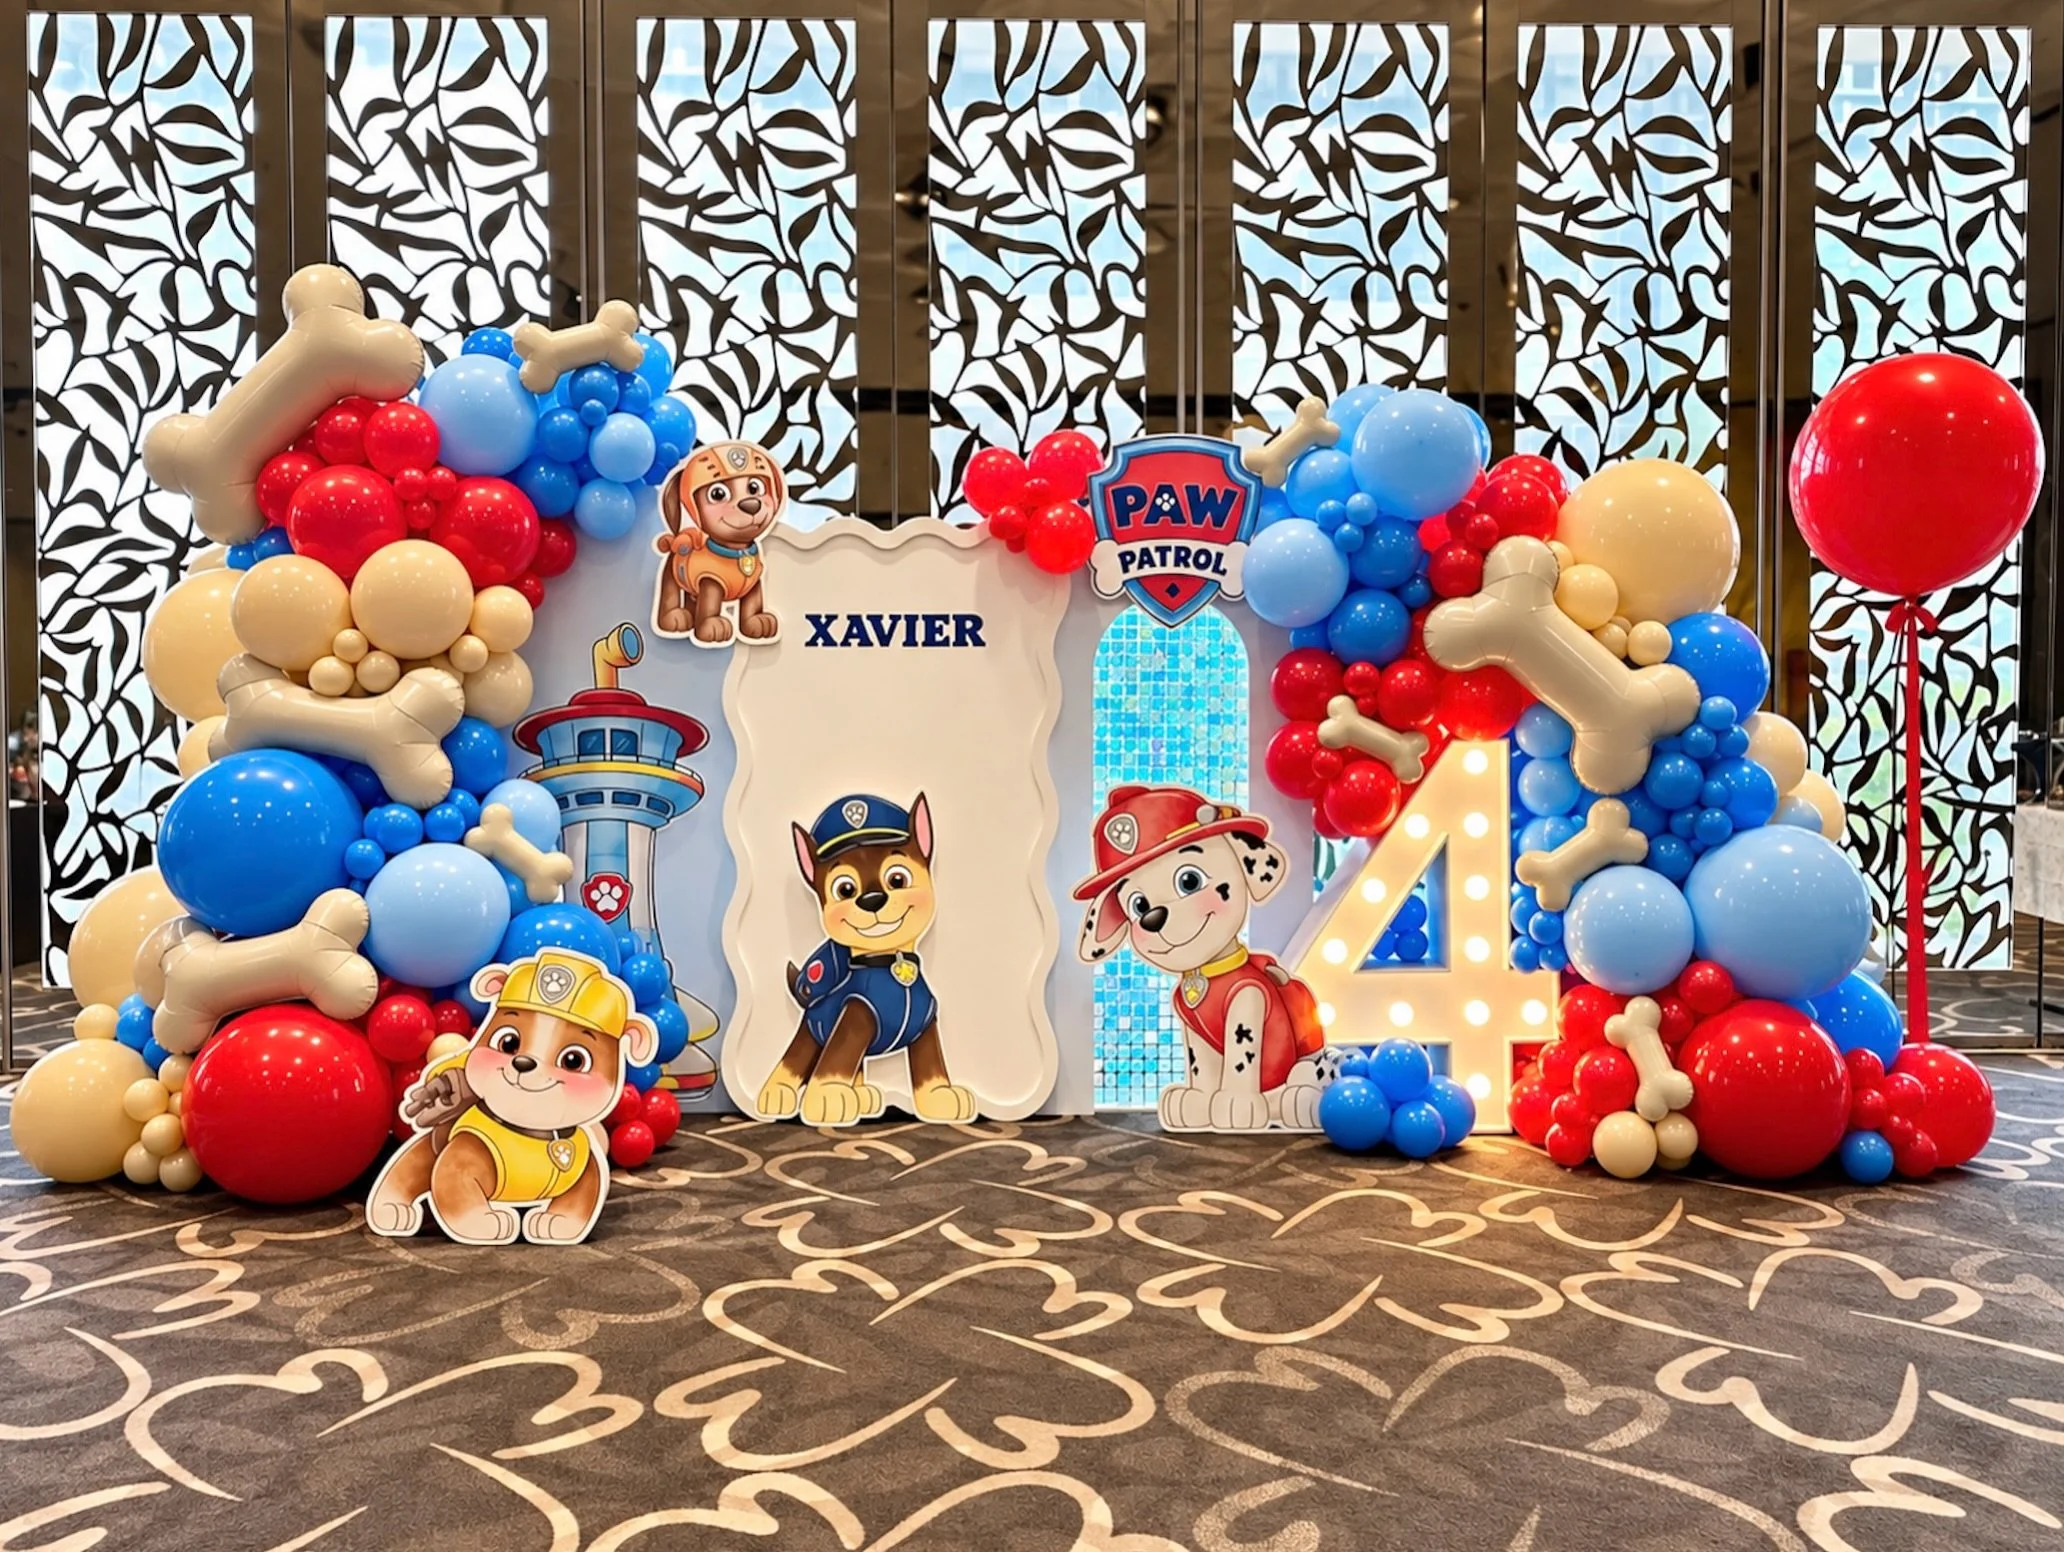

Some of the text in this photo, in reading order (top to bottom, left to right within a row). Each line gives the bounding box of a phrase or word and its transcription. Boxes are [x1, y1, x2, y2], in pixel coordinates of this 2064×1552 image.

[1110, 484, 1240, 529] PAW
[1118, 546, 1227, 576] PATROL
[805, 614, 986, 647] XAVIER
[1290, 737, 1561, 1134] 4
